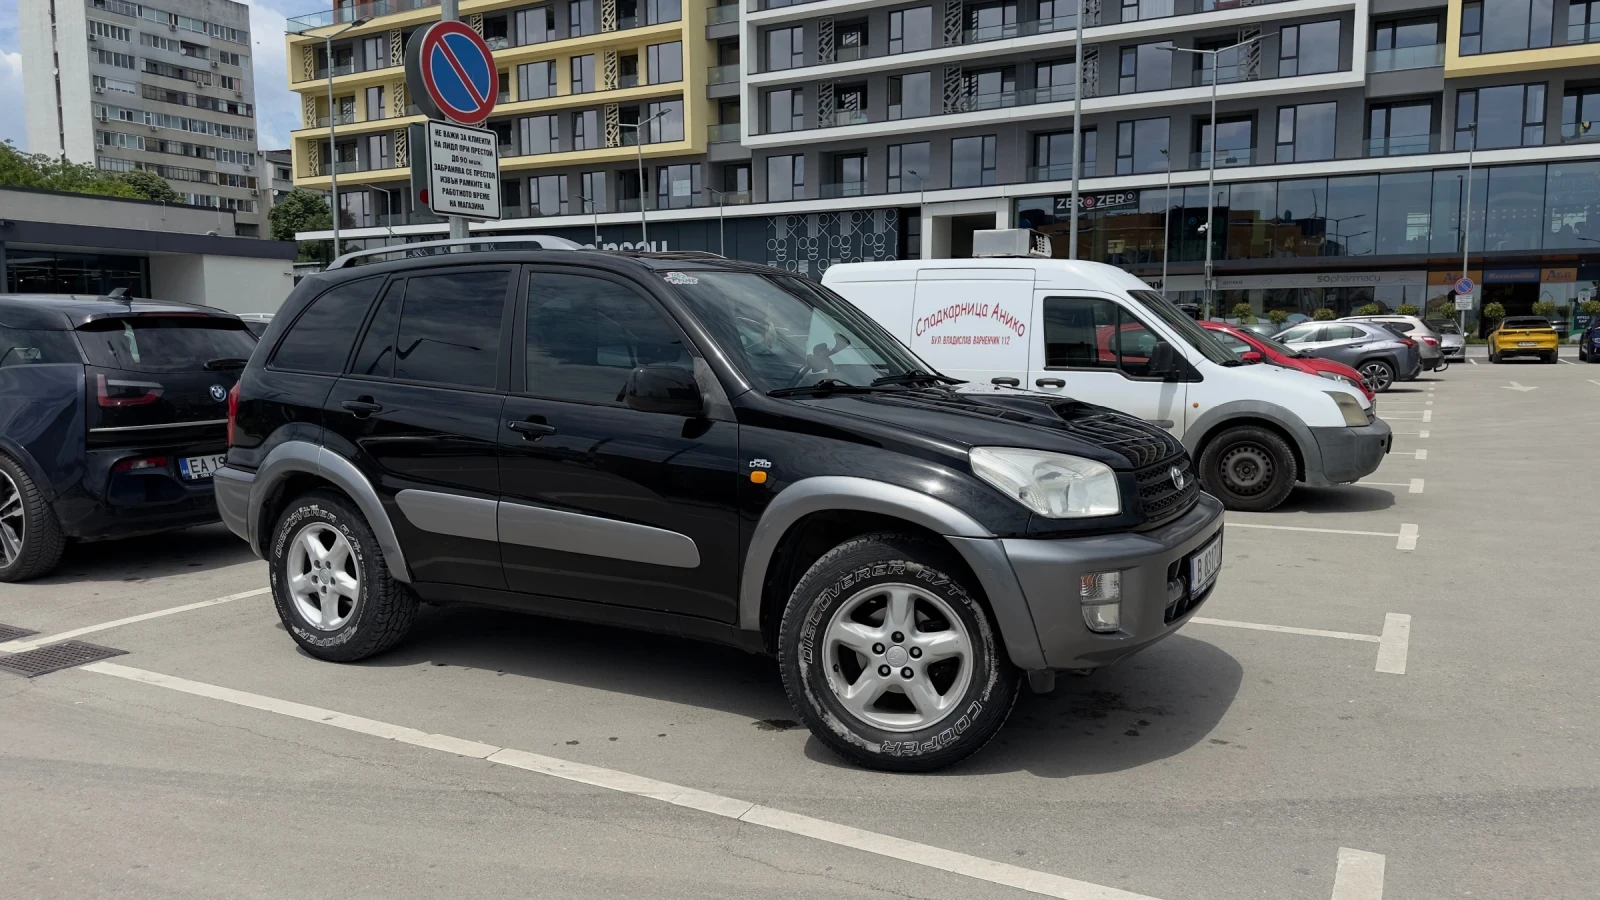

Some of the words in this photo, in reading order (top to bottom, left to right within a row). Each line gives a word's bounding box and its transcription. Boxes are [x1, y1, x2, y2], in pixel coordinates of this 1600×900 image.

[443, 130, 459, 139] ВАЖИ
[468, 135, 491, 145] КЛИЕНТИ
[434, 140, 441, 148] НА
[443, 142, 458, 151] ЛИДЛ
[459, 144, 470, 153] ПРИ
[471, 146, 493, 157] ПРЕСТОЙ
[451, 155, 459, 163] ДО
[434, 163, 465, 174] ЗАБРАНЯВА
[466, 168, 472, 176] СЕ
[474, 170, 495, 179] ПРЕСТОЯ
[440, 176, 458, 185] ИЗВЪН
[460, 179, 483, 188] РАМКИТЕ
[442, 188, 472, 198] РАБОТНОТО
[473, 192, 490, 200] ВРЕМЕ
[458, 201, 484, 210] МАГАЗИНА
[1317, 274, 1381, 283] sopharmacy
[916, 302, 988, 336] Сладкарница
[991, 302, 1025, 337] Анико
[943, 336, 971, 345] ВЛАДИСЛАВ
[973, 336, 1000, 345] ВАРНЕНЧИК
[1001, 336, 1010, 345] 112
[190, 458, 209, 473] EA
[274, 504, 337, 559] DISCOVERER
[802, 564, 906, 665] DISCOVERER
[299, 625, 358, 647] COOPER
[881, 700, 983, 753] COOPER
